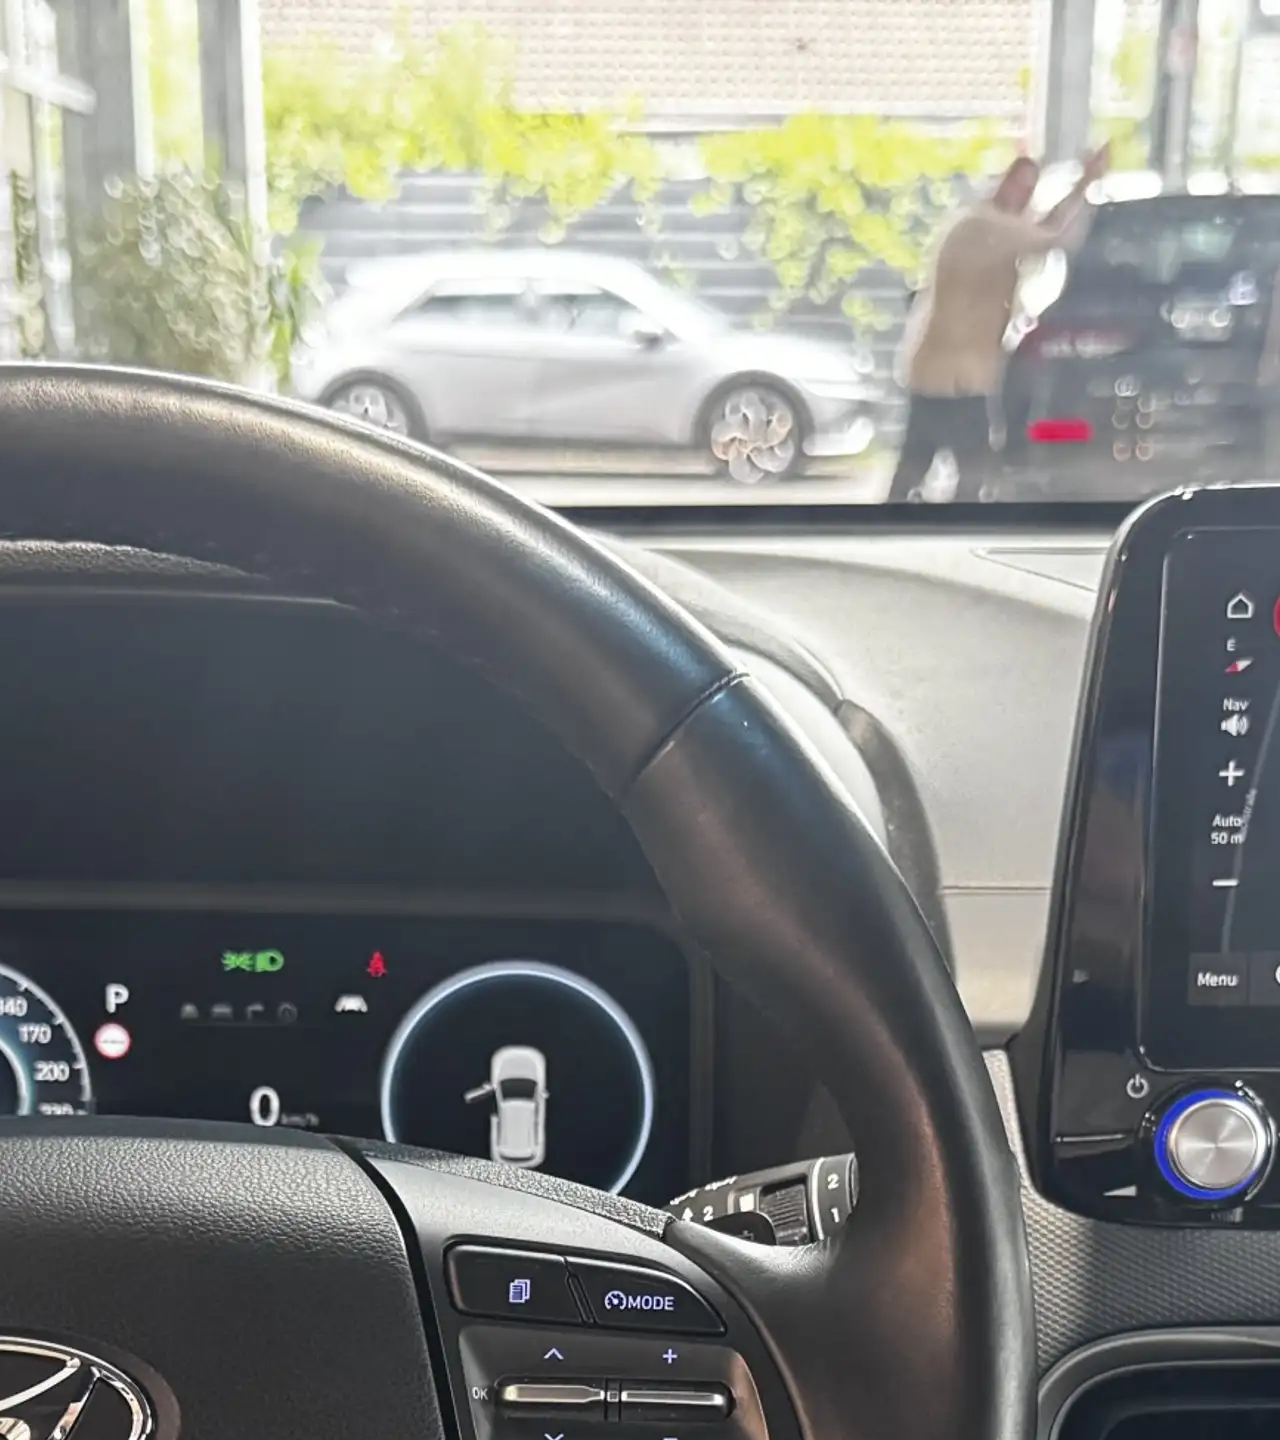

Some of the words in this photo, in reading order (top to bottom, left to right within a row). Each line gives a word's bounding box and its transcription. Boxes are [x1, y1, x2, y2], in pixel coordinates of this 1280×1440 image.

[1222, 697, 1250, 712] Nav
[1212, 814, 1243, 828] Auto
[1210, 832, 1228, 845] 50
[1196, 970, 1240, 988] Menu
[105, 983, 130, 1014] P
[18, 1024, 52, 1044] 170
[33, 1061, 70, 1082] 200
[249, 1085, 281, 1128] 0
[627, 1295, 675, 1311] MODE
[471, 1386, 489, 1401] OK
